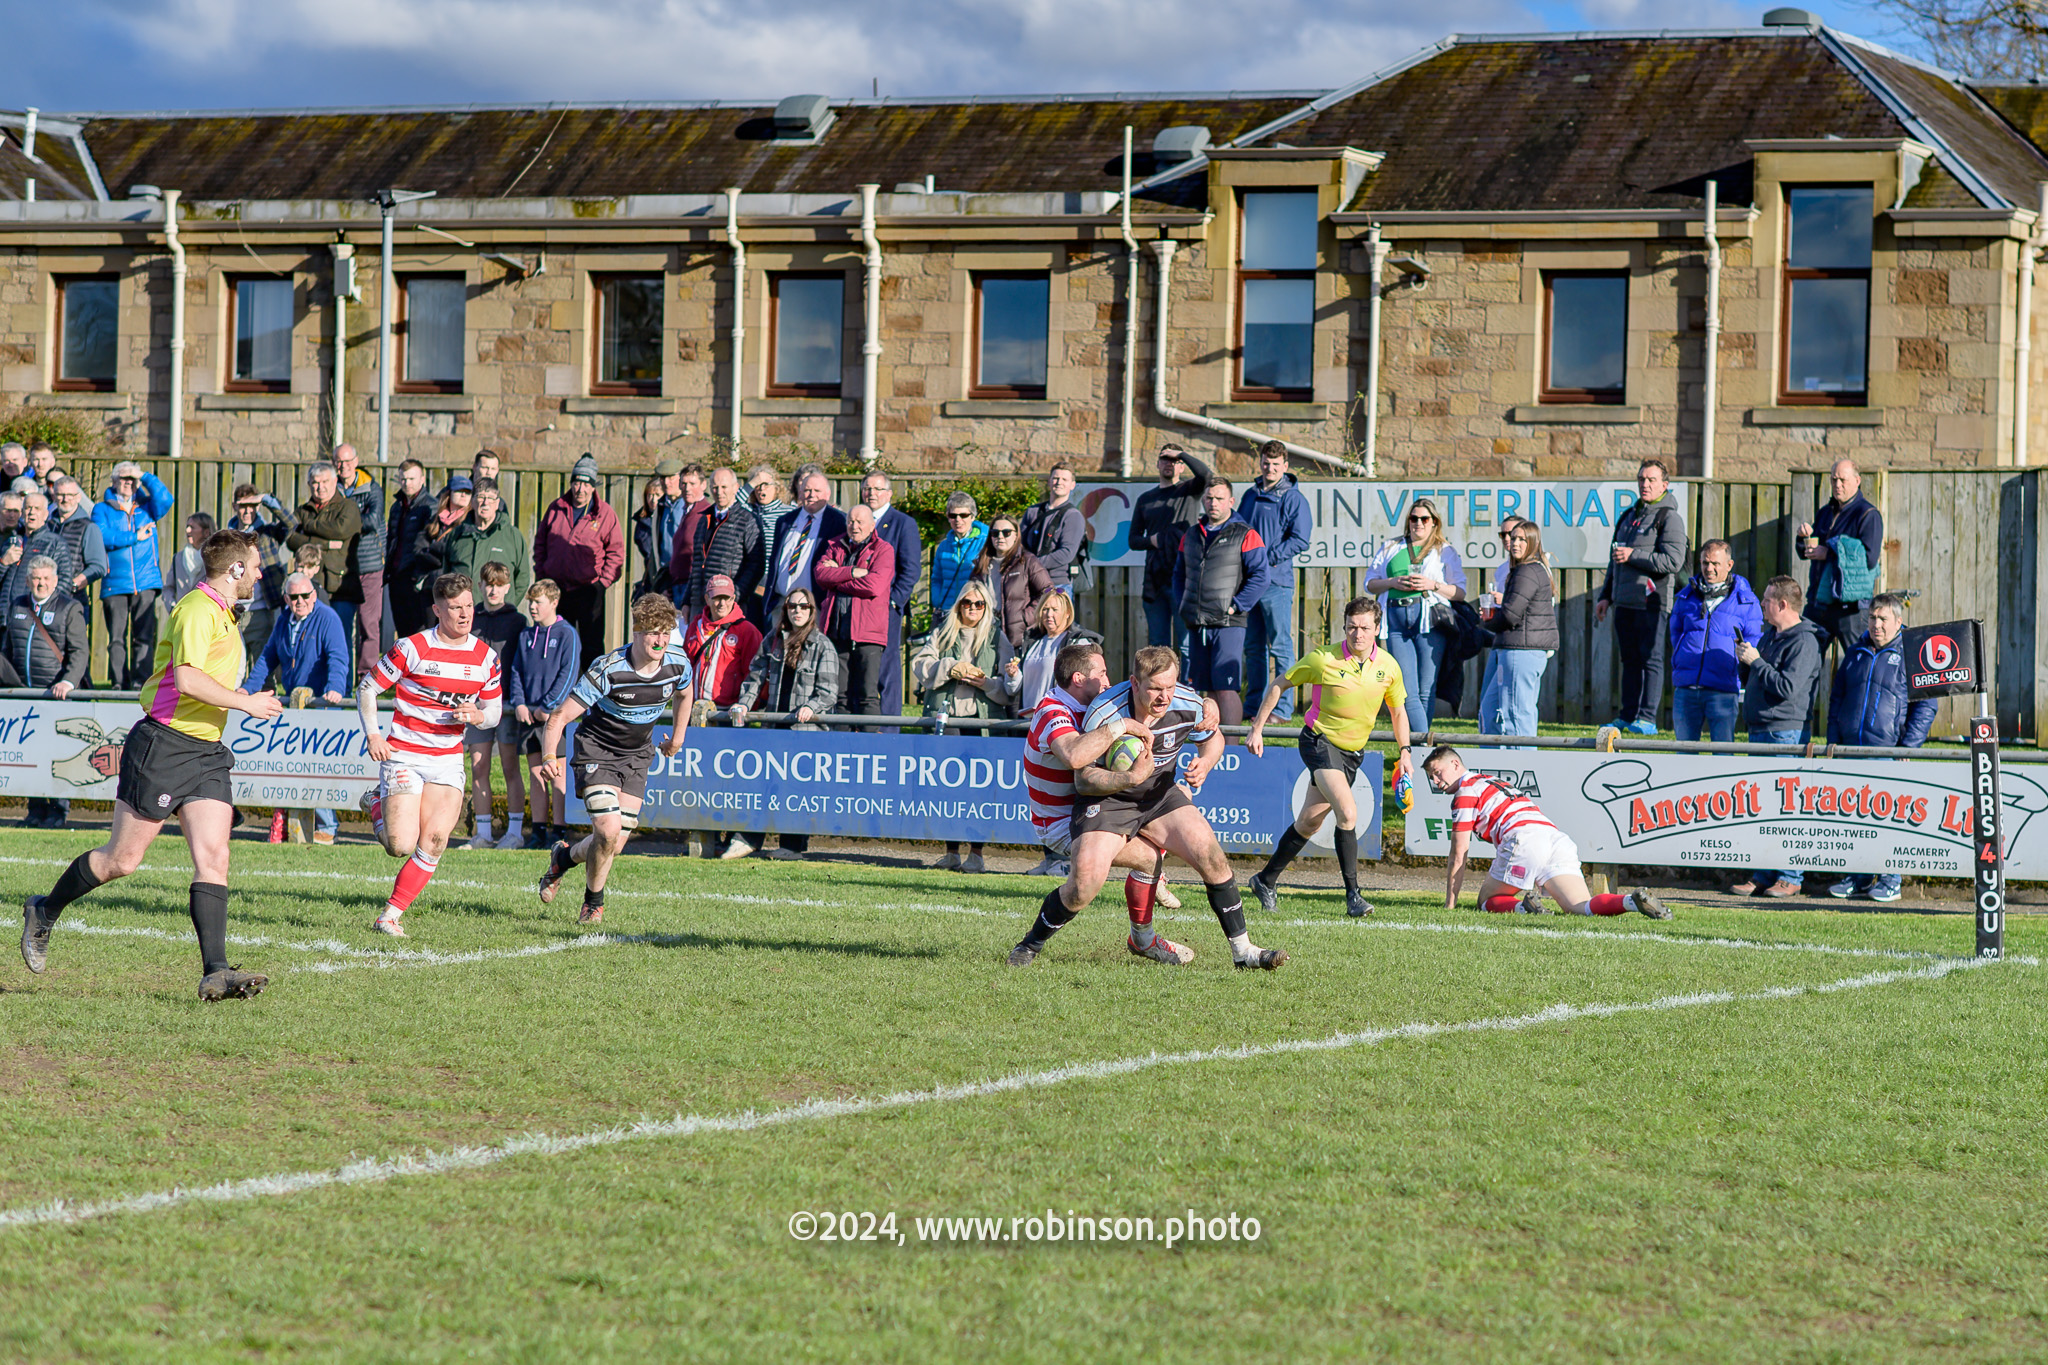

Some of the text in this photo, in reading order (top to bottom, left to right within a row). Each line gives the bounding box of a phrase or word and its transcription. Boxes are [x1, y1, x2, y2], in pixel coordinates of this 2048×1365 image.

[233, 760, 365, 775] ROOFING CONTRACTOR
[713, 749, 887, 785] CONCRETE
[898, 755, 1029, 790] PRODU
[236, 782, 348, 802] Tel: 07970 277 539
[670, 790, 763, 811] CONCRETE
[768, 795, 780, 811] &
[786, 795, 830, 814] CAST
[834, 796, 893, 816] STONE
[899, 799, 1031, 822] MANUFACTUR
[1629, 780, 1762, 837] Ancroft
[1775, 776, 1929, 827] Tractors
[1759, 826, 1878, 839] BERWICK-UPON-TWEED
[1700, 839, 1732, 849] KELSO
[1782, 840, 1854, 851] 01289 331904
[1681, 852, 1751, 862] 01573 225213
[1893, 847, 1950, 857] MACMERRY
[1789, 856, 1847, 867] SWARLAND
[1885, 860, 1958, 870] 01875 617323
